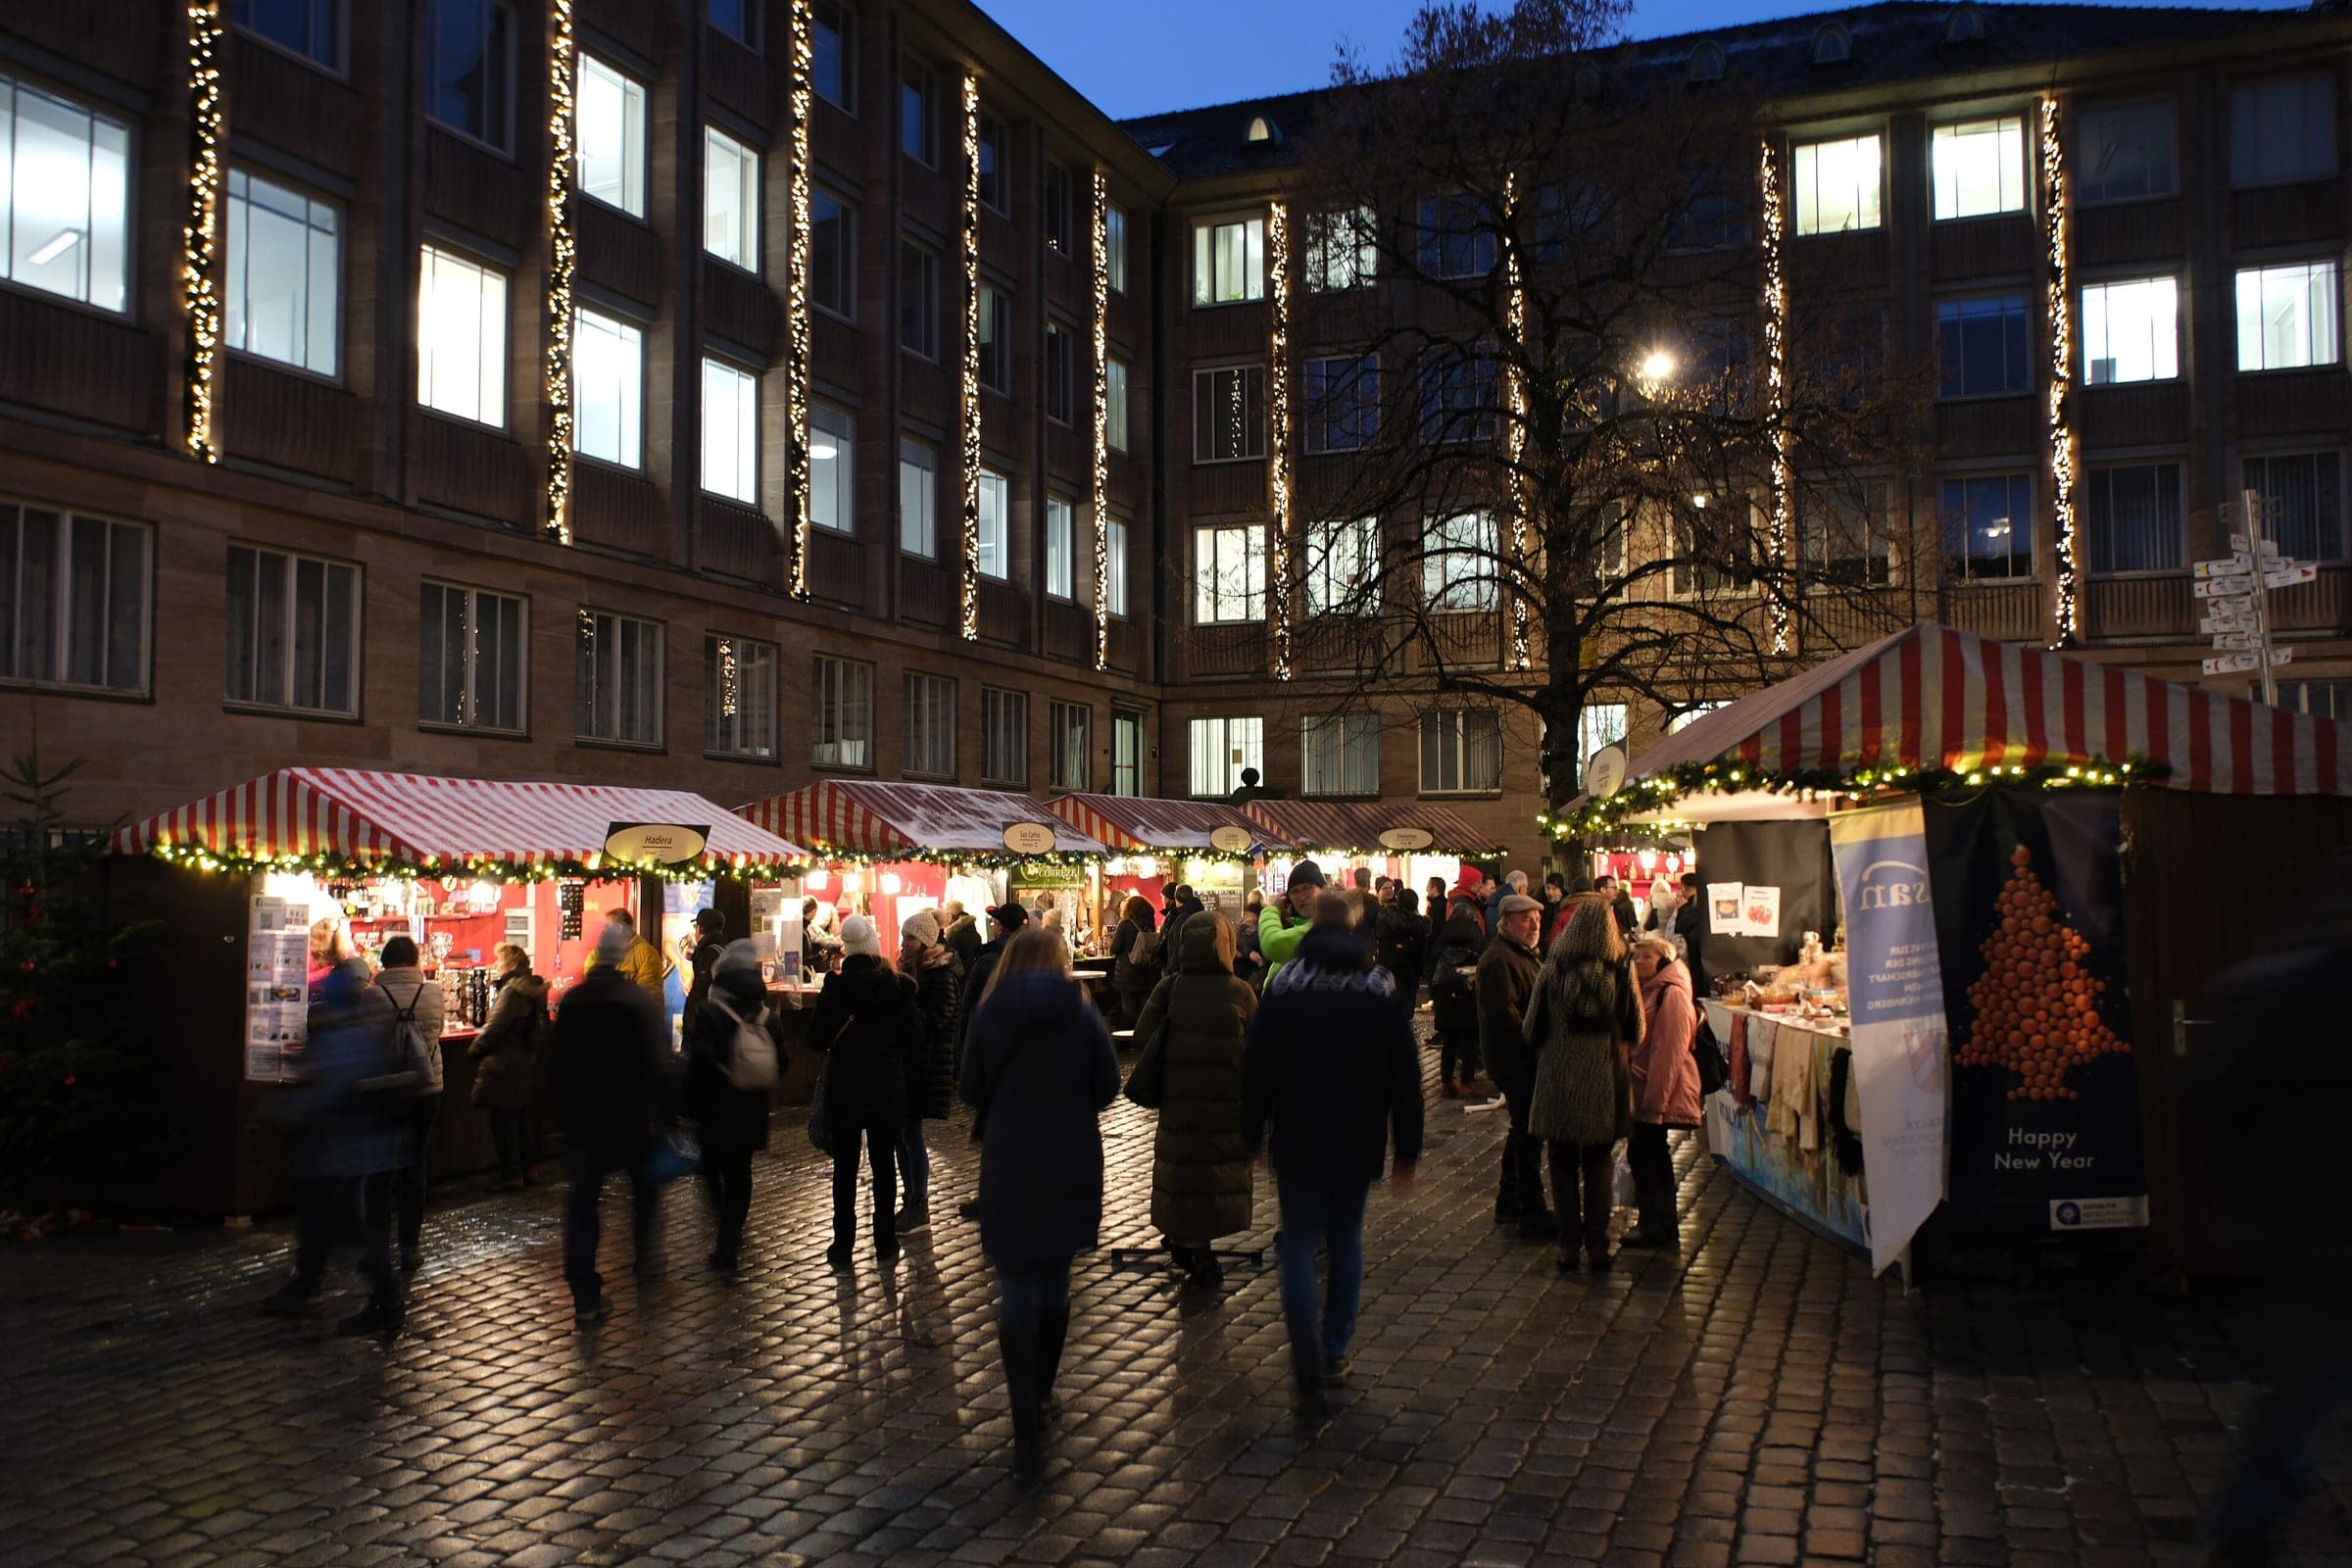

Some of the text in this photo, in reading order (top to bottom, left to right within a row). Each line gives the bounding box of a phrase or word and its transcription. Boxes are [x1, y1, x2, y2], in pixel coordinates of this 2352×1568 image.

[644, 835, 672, 846] Hadera
[2008, 1127, 2078, 1150] Happy
[1993, 1152, 2095, 1170] New Year
